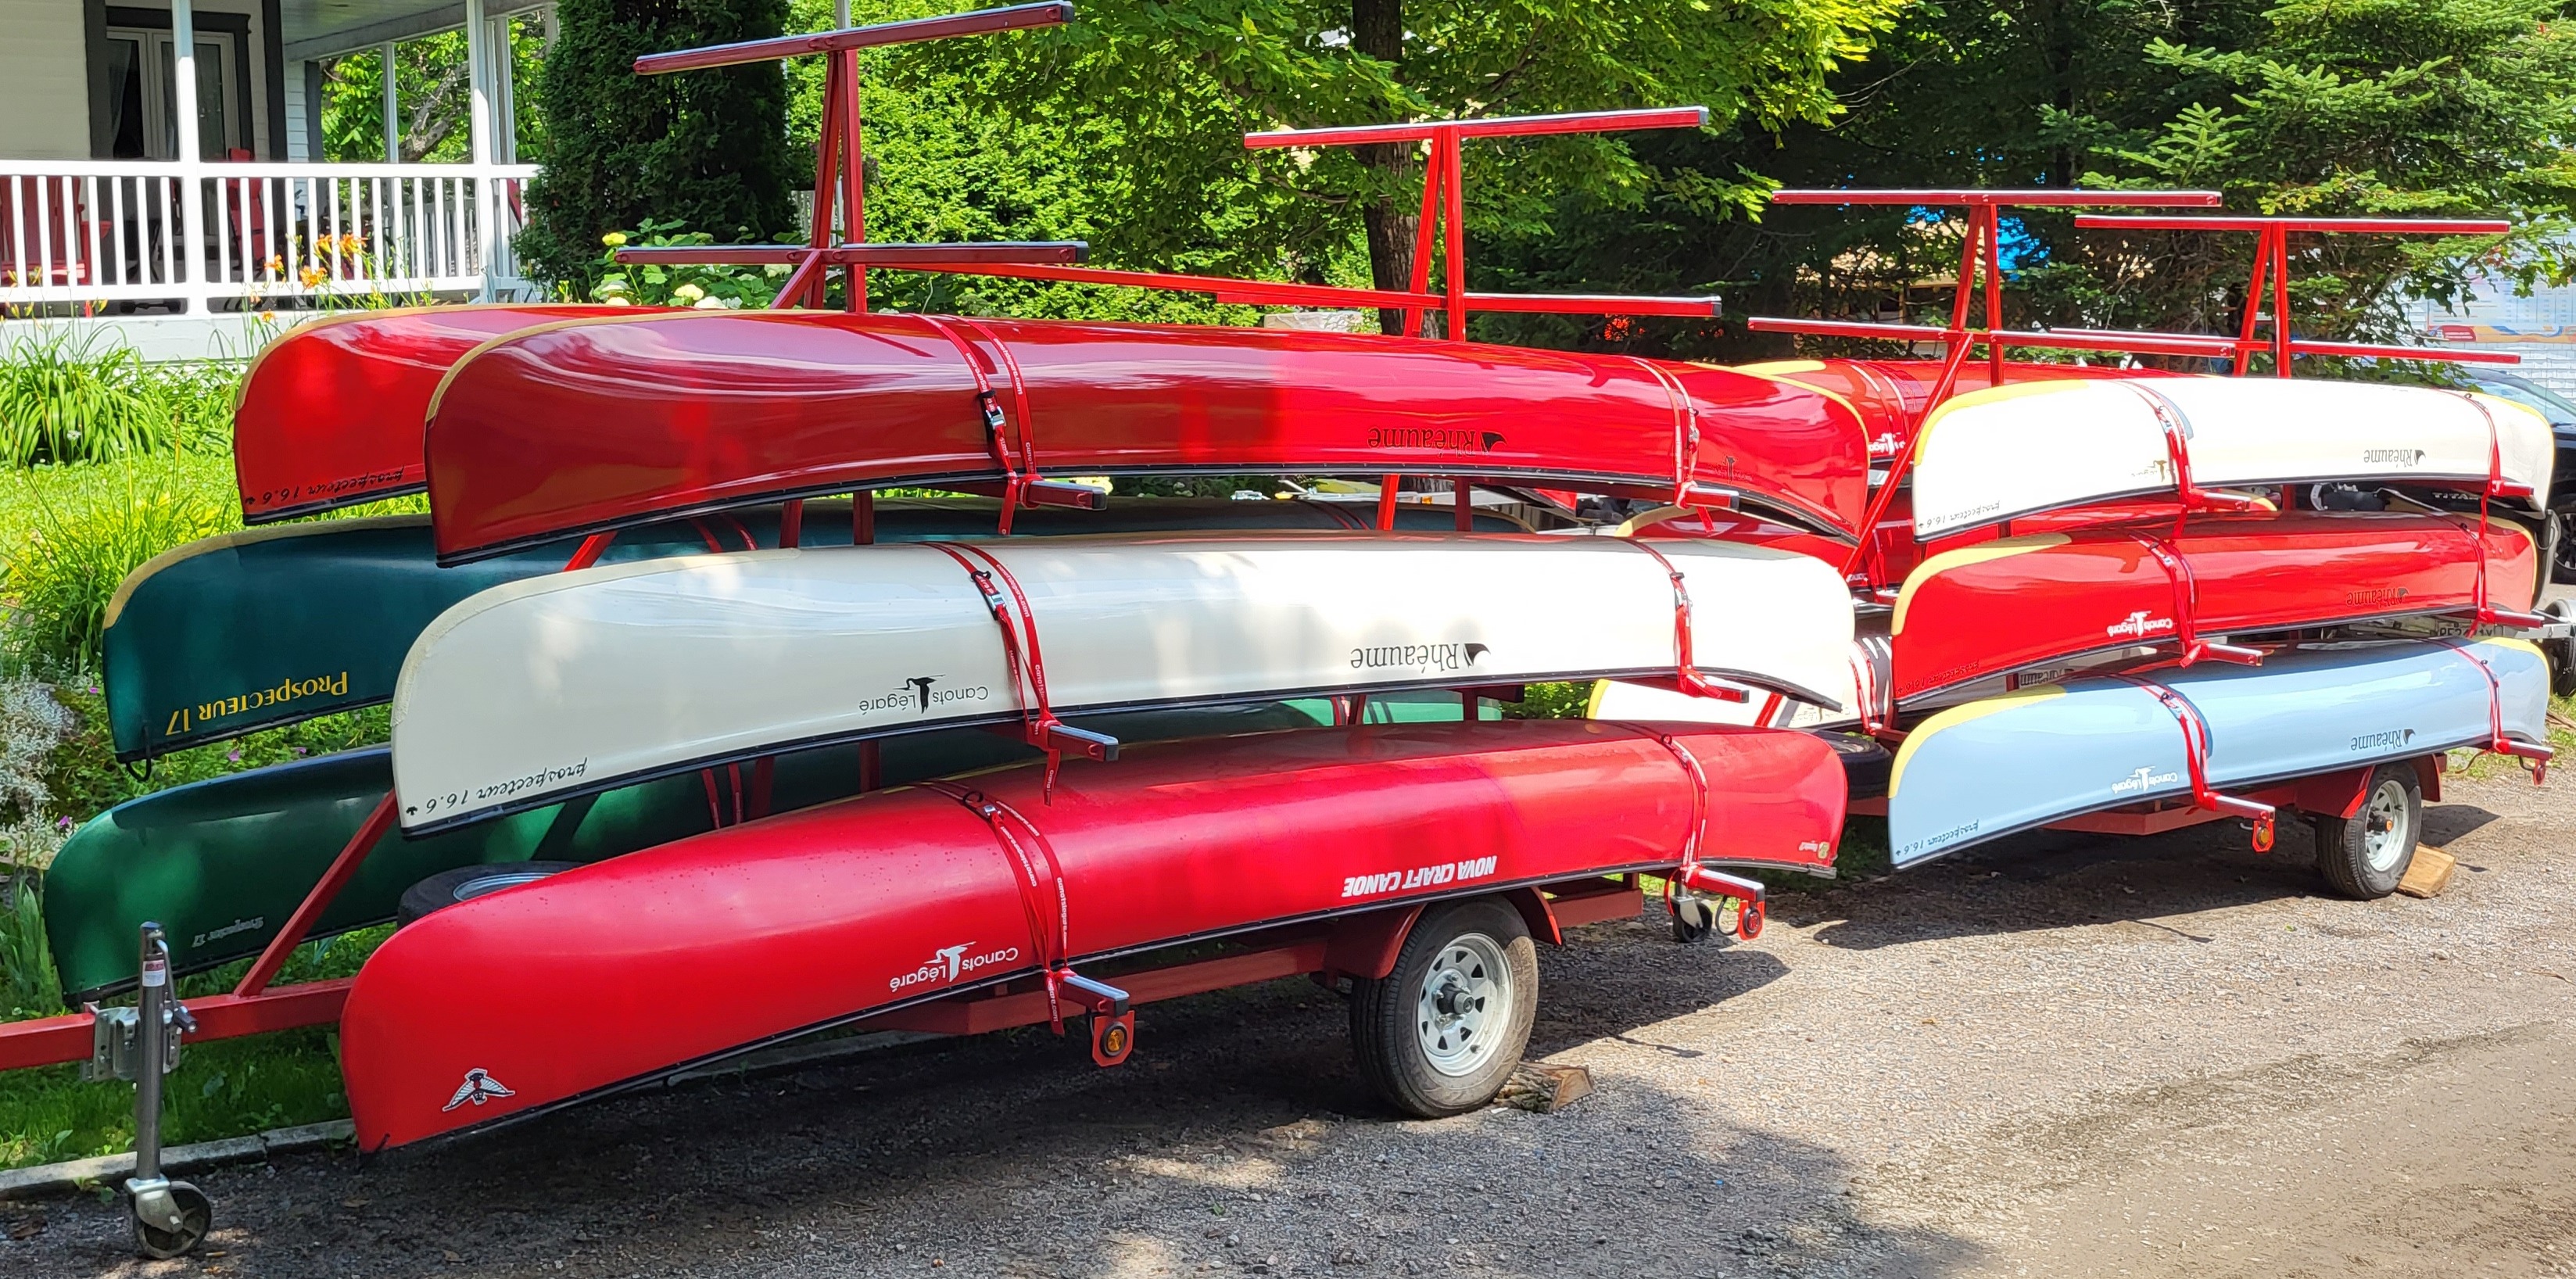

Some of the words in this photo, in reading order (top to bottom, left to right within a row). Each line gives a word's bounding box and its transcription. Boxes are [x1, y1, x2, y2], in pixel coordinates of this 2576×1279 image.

[1367, 426, 1477, 458] Rhéaume
[2363, 449, 2413, 468] Rhéaume
[262, 485, 300, 504] 16.6
[1350, 643, 1459, 675] Rhéaume
[858, 693, 916, 715] Légaré
[932, 686, 988, 705] Canots
[165, 708, 192, 736] 17
[2350, 729, 2402, 751] Rhéaume
[475, 757, 588, 800] prospecteur
[425, 790, 468, 814] 16.6
[1904, 840, 1924, 855] 16.6
[1402, 863, 1455, 890] CRAFT
[1457, 855, 1497, 880] NOVA
[1341, 871, 1402, 897] CANOE
[962, 948, 1019, 971] Canots
[890, 966, 946, 992] Légaré
